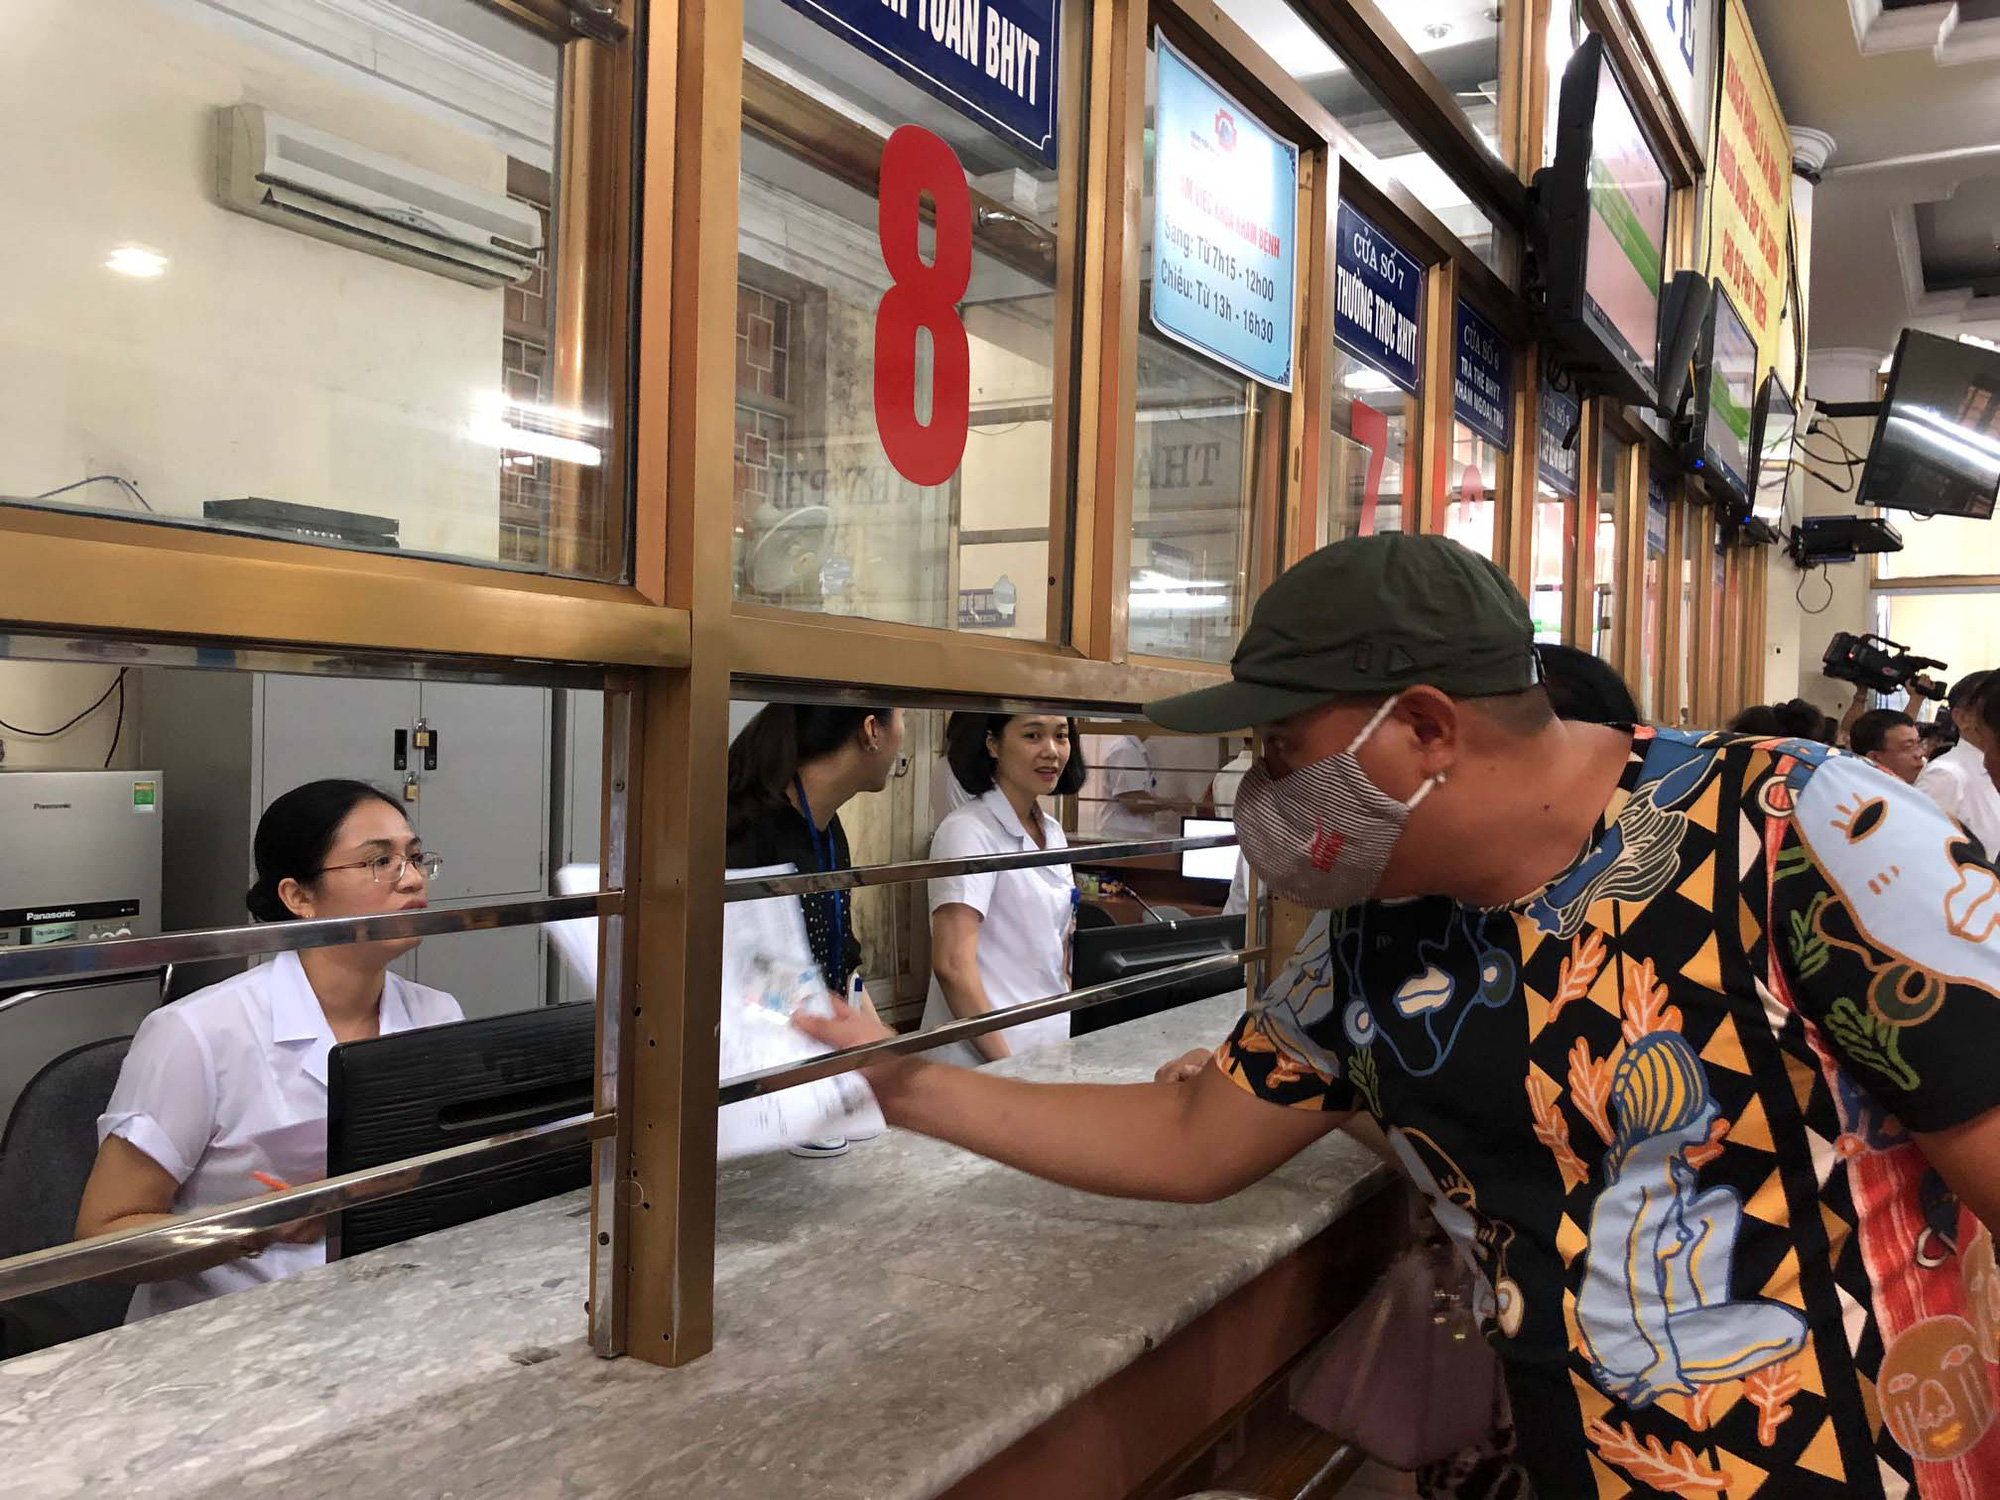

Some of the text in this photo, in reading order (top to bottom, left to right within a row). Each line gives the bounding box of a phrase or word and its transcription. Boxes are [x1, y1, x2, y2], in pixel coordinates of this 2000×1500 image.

[985, 5, 1040, 106] BHYT
[1197, 235, 1211, 265] Từ
[1212, 244, 1236, 281] 7h15
[1245, 267, 1274, 302] 12h00
[1380, 248, 1396, 285] SỐ
[1398, 269, 1405, 291] 7
[874, 123, 972, 487] 8
[1196, 279, 1211, 309] Từ
[1214, 292, 1231, 322] 13h
[1244, 308, 1274, 344] 16h30
[1336, 265, 1417, 366] THƯỜNG TRỰC BHYT
[1485, 376, 1501, 401] BHYT
[26, 908, 77, 922] Panasonic
